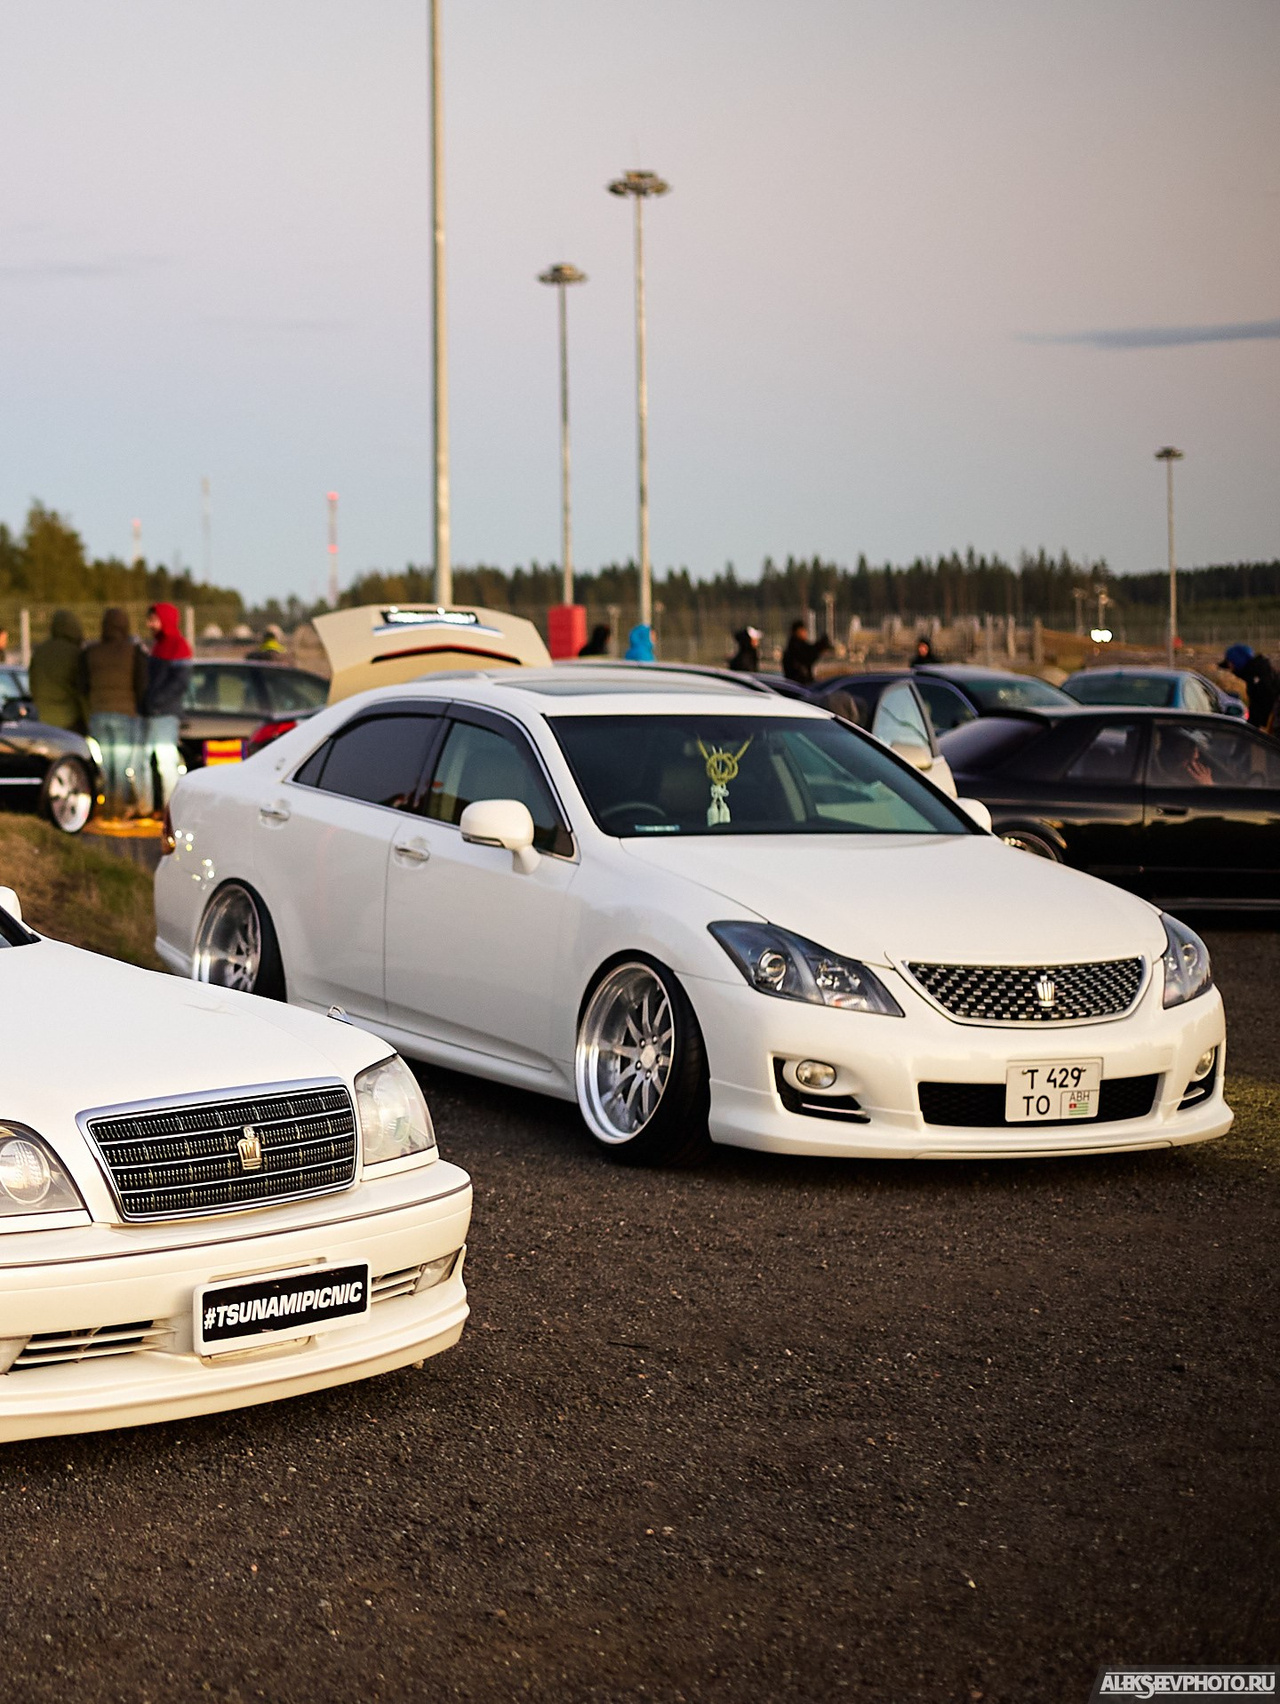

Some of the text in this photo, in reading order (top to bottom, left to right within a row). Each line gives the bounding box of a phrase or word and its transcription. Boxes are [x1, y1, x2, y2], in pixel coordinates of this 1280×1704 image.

[1027, 1067, 1081, 1089] T 429
[1023, 1095, 1050, 1116] TO
[204, 1281, 363, 1330] #TSUNAMIPICNIC
